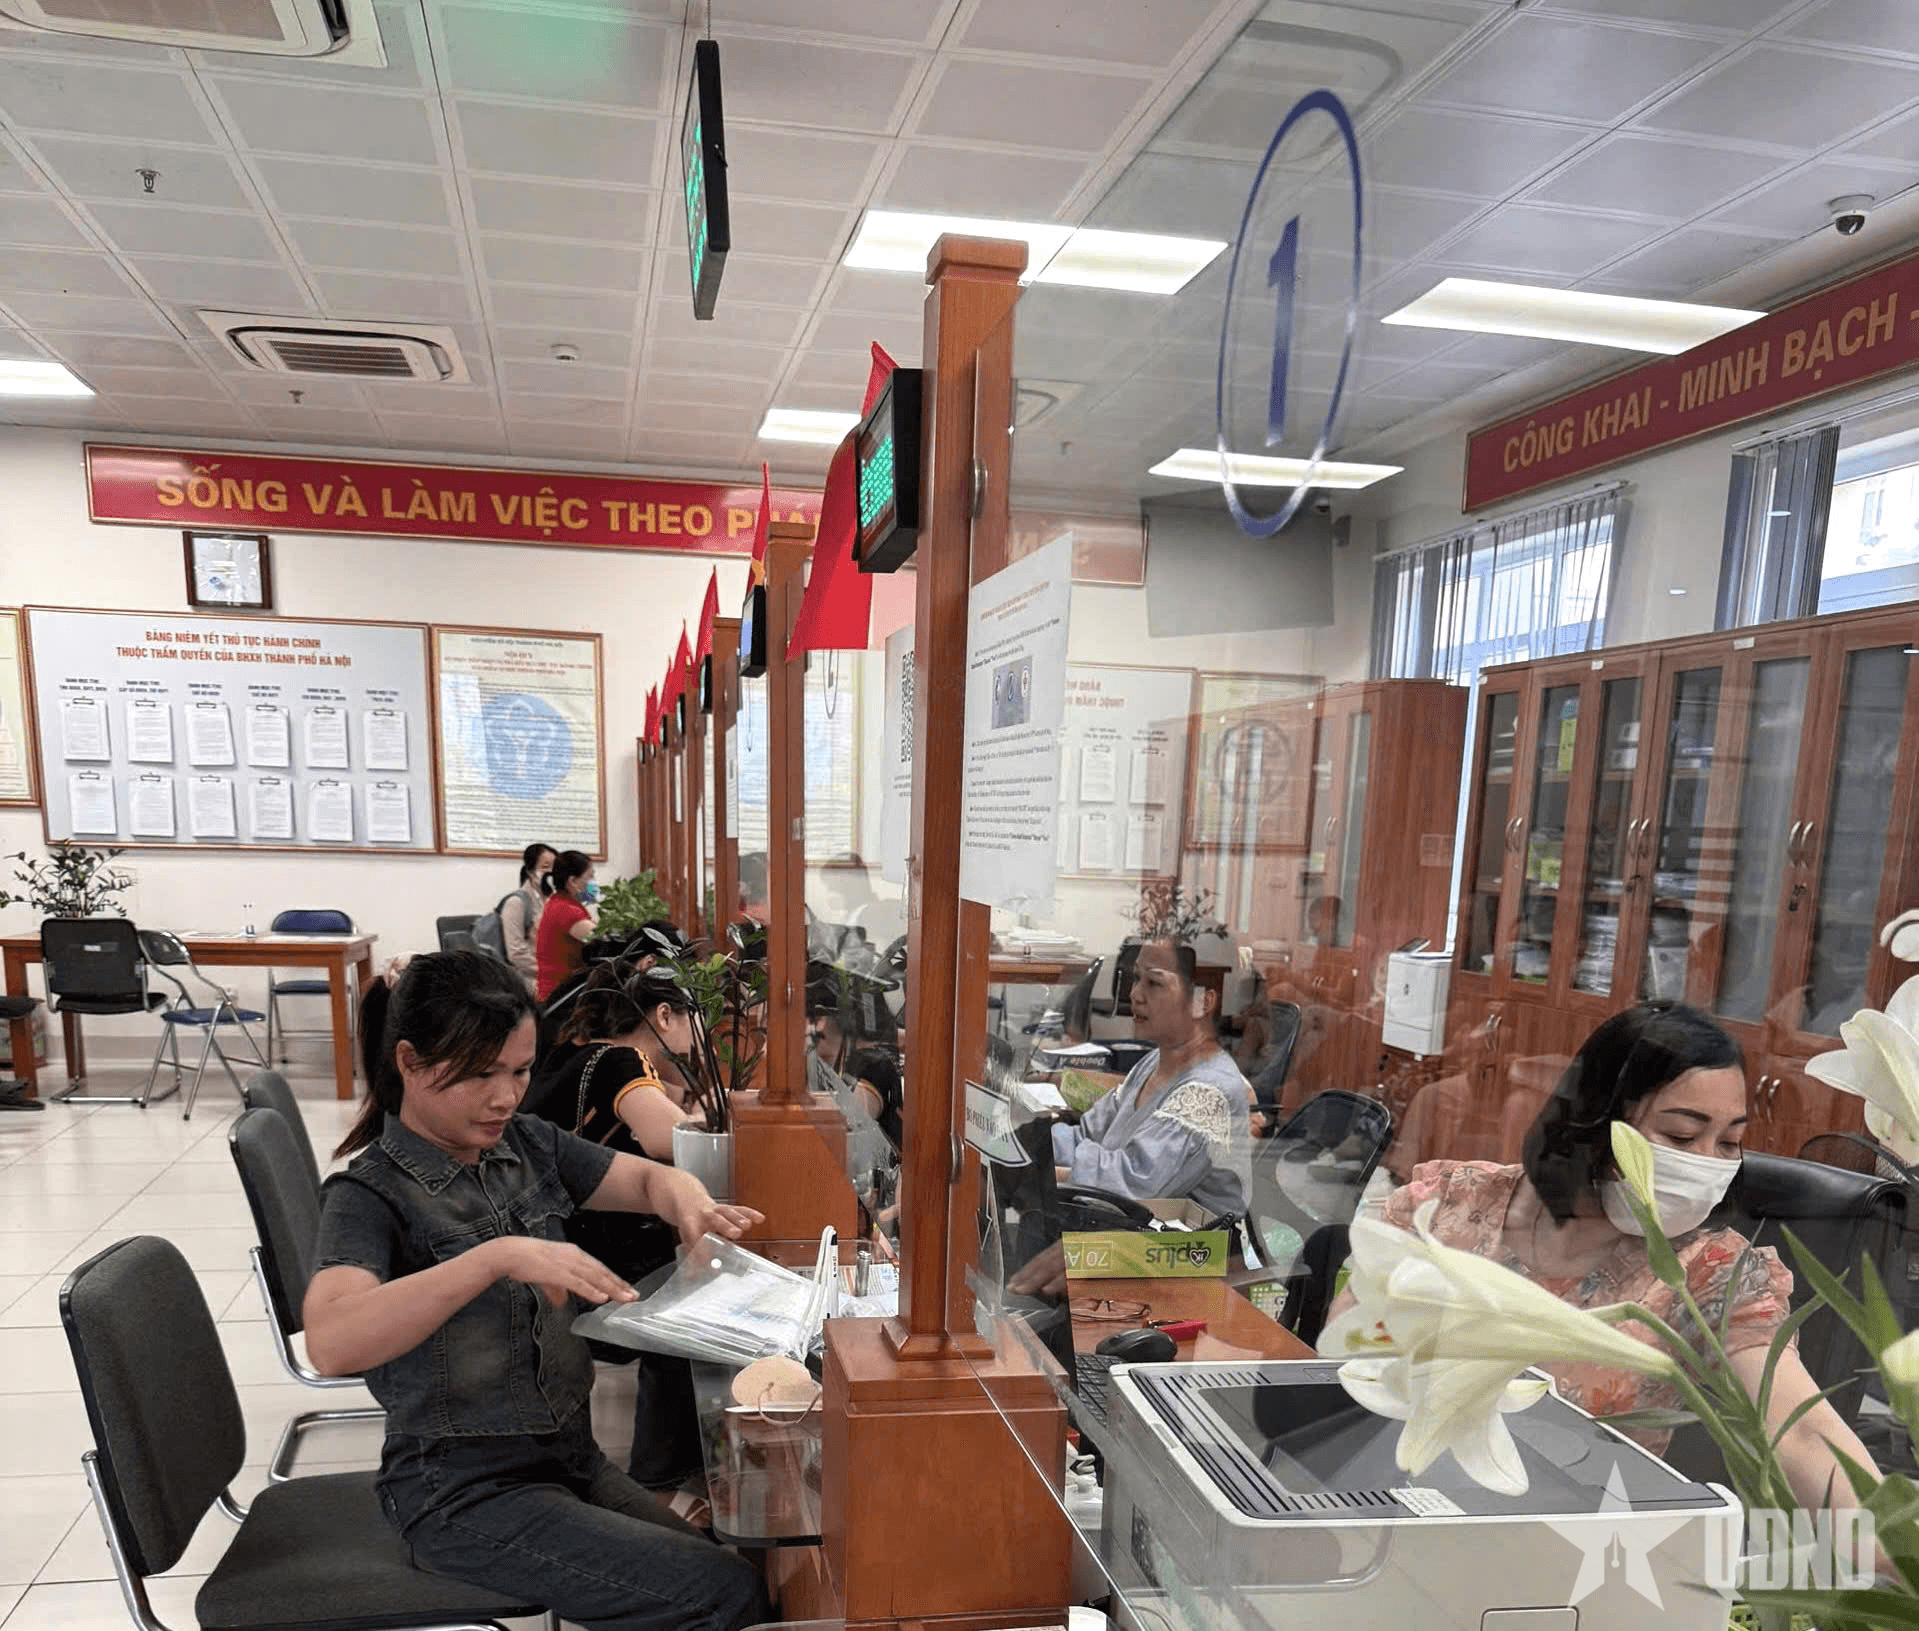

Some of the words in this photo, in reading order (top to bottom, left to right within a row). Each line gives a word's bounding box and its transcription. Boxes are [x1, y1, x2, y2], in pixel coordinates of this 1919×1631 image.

[1266, 214, 1301, 447] 1
[1503, 419, 1575, 473] CÔNG
[1581, 385, 1652, 448] KHAI
[1678, 341, 1770, 413] MINH
[1781, 293, 1899, 381] BẠCH
[157, 464, 289, 512] SỐNG
[302, 475, 368, 517] VÀ
[382, 478, 477, 522] LÀM
[490, 487, 589, 536] VIỆC
[601, 501, 713, 536] THEO
[1087, 1251, 1109, 1267] 70
[1146, 1241, 1191, 1268] plus
